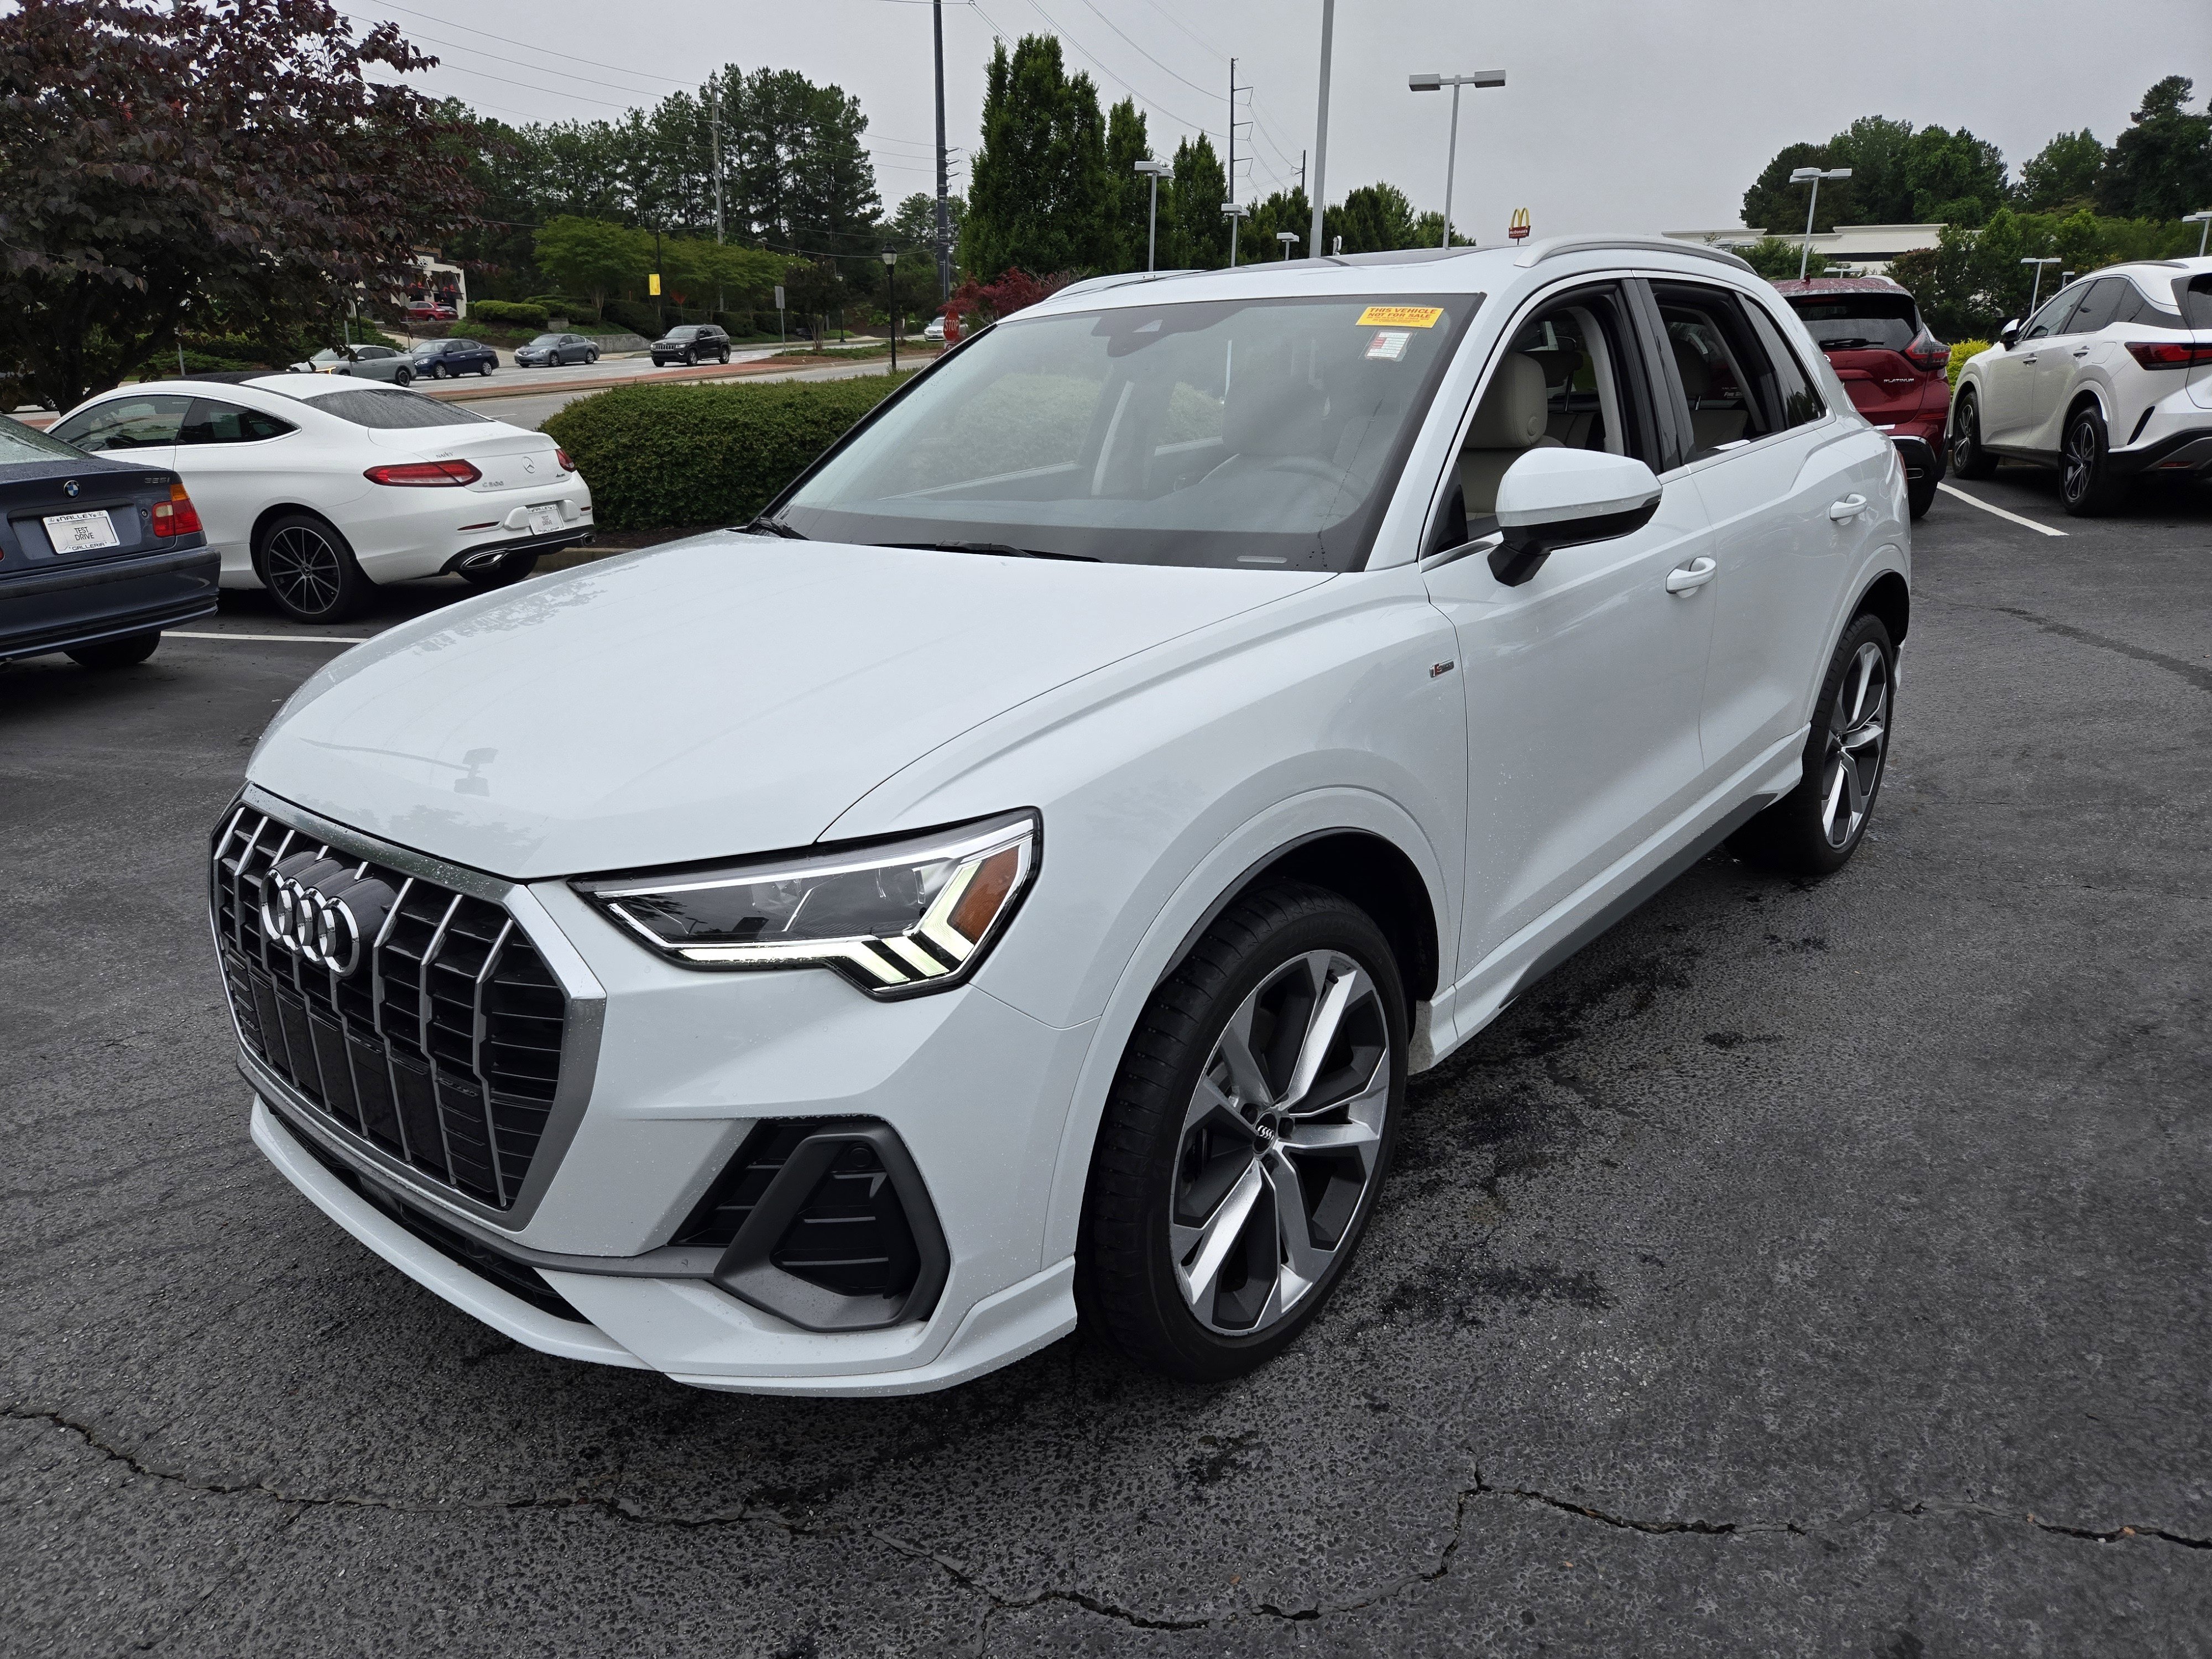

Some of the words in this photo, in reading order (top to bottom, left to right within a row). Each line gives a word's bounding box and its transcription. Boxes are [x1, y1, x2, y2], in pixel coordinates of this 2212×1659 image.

[944, 320, 959, 331] STOP
[75, 533, 95, 541] DRIVE
[72, 542, 105, 551] GALLERIA
